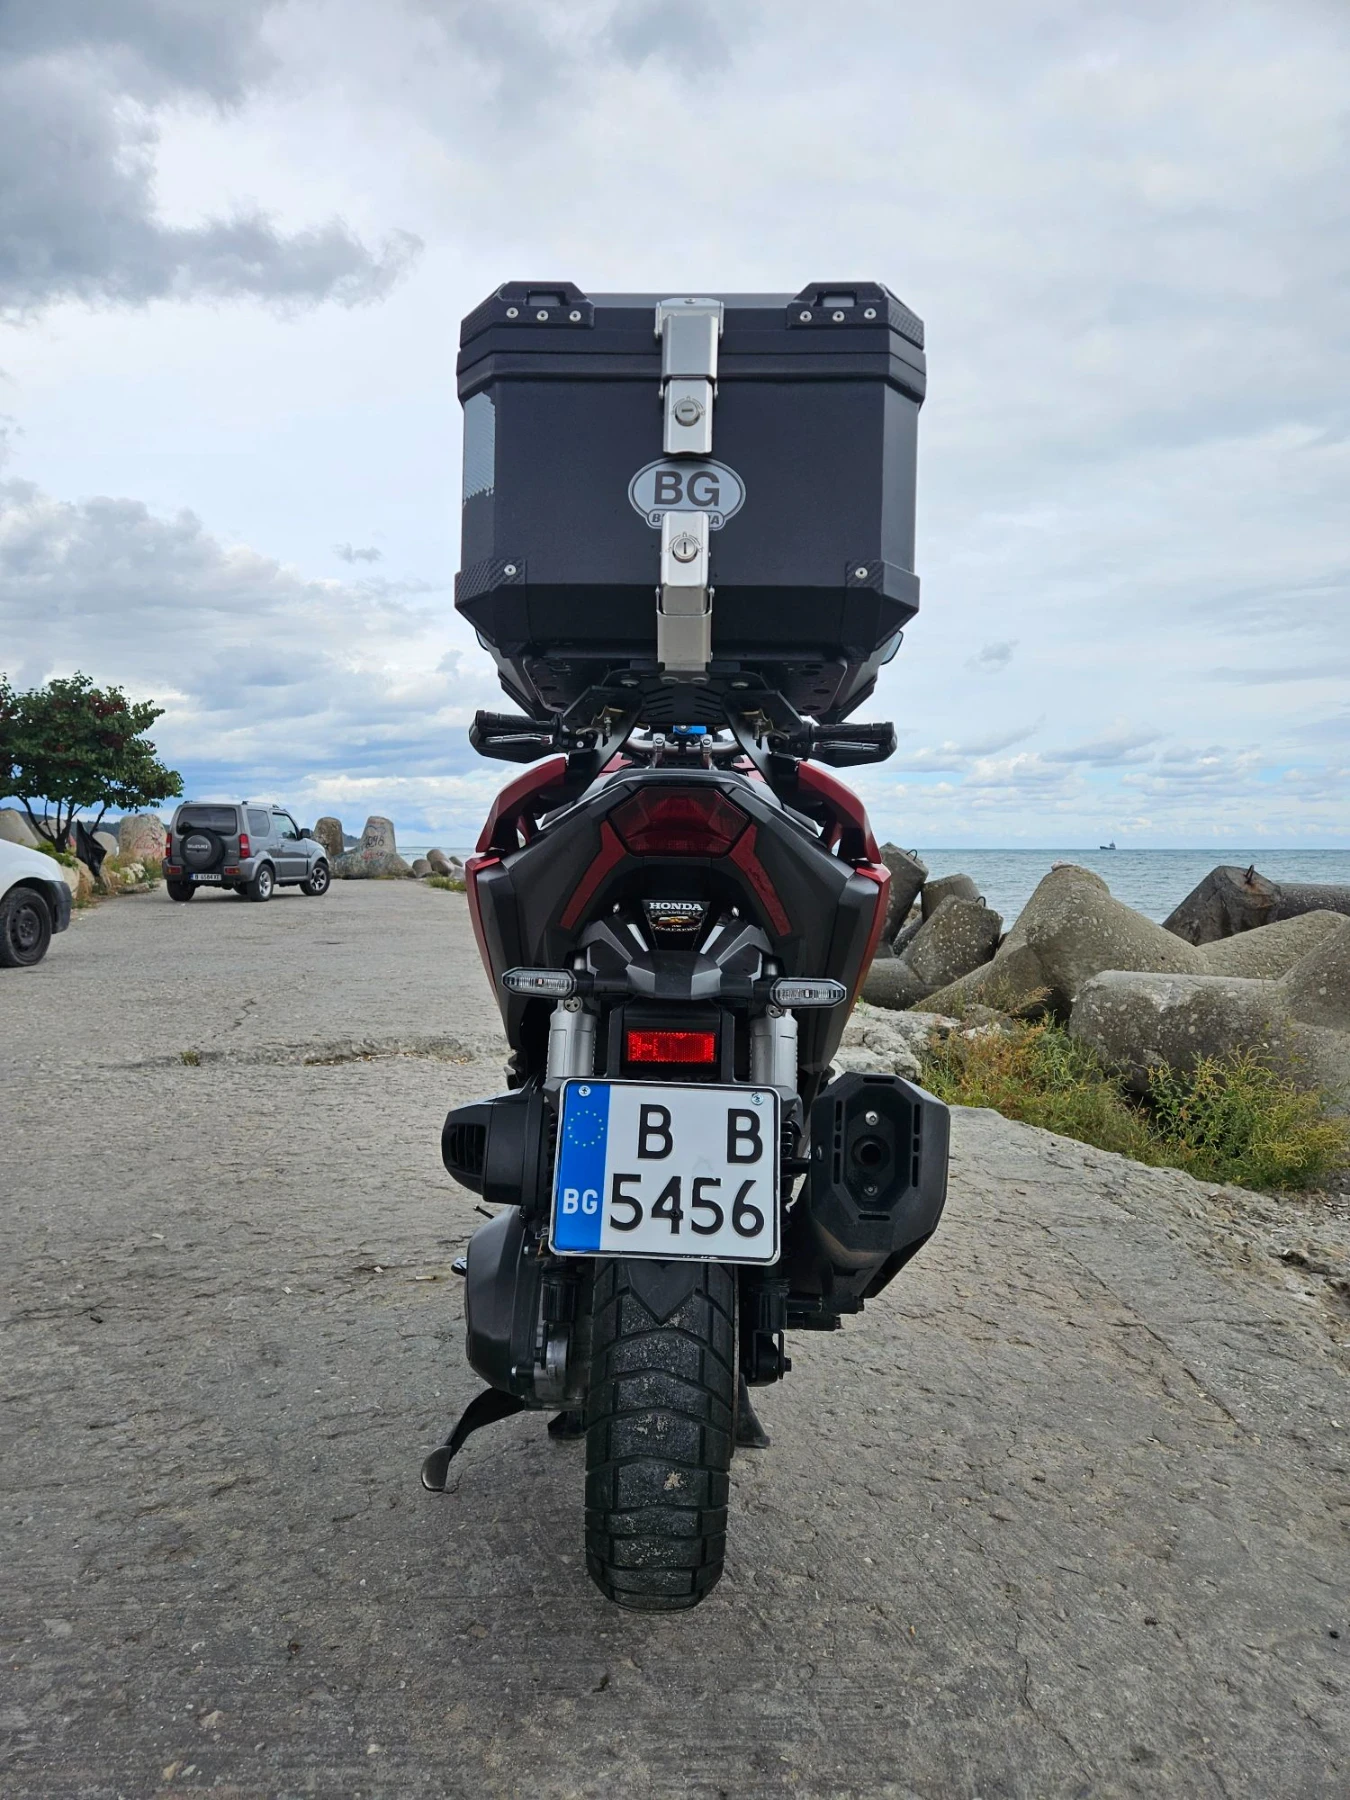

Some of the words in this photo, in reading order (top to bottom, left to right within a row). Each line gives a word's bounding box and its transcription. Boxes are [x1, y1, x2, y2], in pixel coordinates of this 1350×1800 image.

[654, 470, 720, 507] BG
[649, 902, 703, 911] HONDA
[637, 1103, 674, 1160] B
[726, 1108, 764, 1164] B
[562, 1188, 599, 1215] BG
[610, 1173, 765, 1238] 5456
